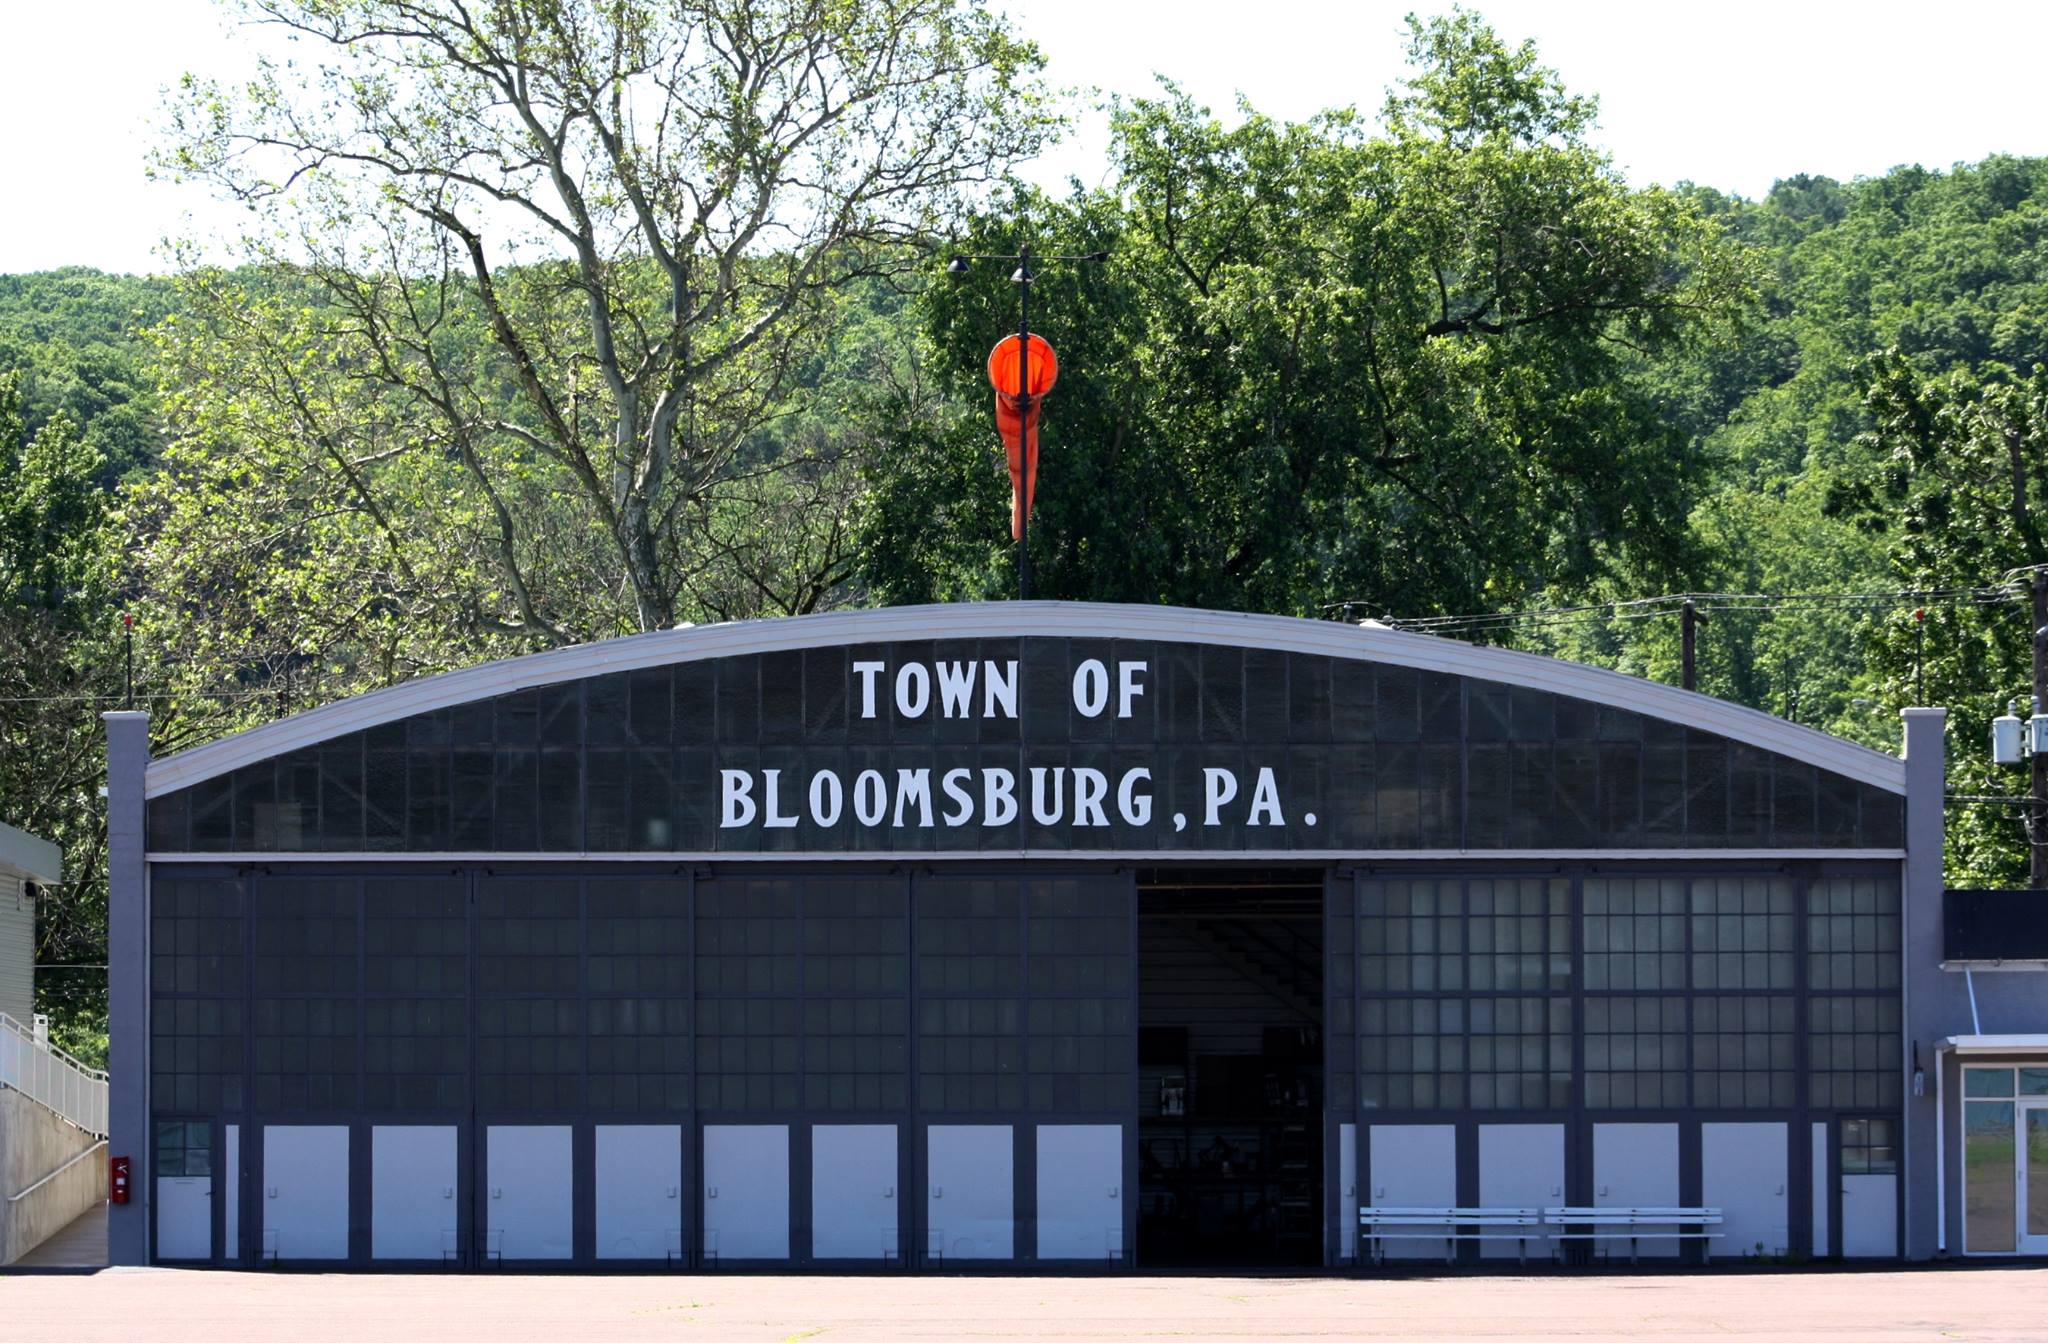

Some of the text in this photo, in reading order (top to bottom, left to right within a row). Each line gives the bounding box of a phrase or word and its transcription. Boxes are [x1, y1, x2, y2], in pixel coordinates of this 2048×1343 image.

[853, 658, 1147, 719] TOWN OF
[719, 767, 1317, 832] BLOOMSBURG, PA.
